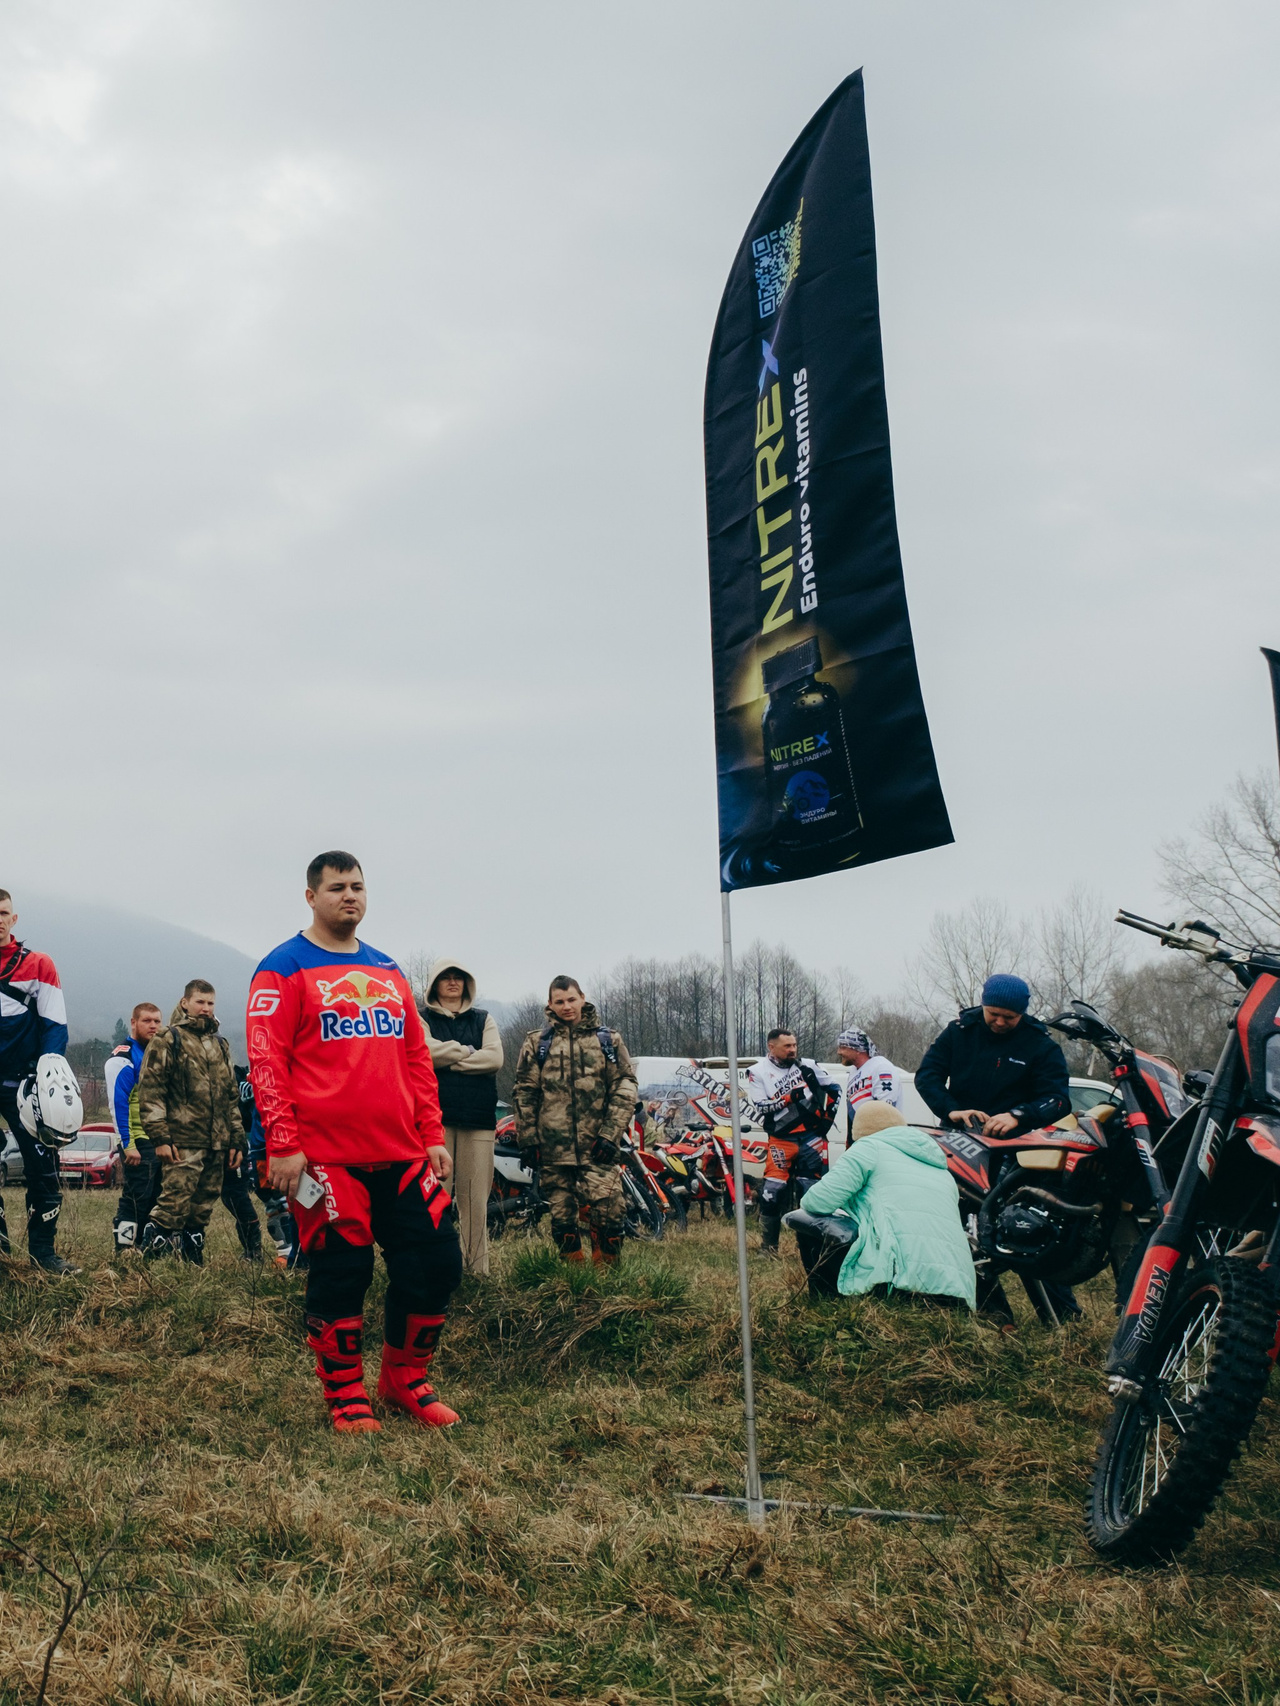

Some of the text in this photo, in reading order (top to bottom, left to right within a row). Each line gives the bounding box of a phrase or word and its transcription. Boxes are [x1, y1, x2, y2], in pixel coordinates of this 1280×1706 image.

[754, 338, 794, 636] NITREX
[789, 367, 819, 614] Enduro vitamins
[770, 730, 830, 762] NITREX
[321, 1010, 371, 1039] Red
[1132, 1263, 1171, 1344] KENDA
